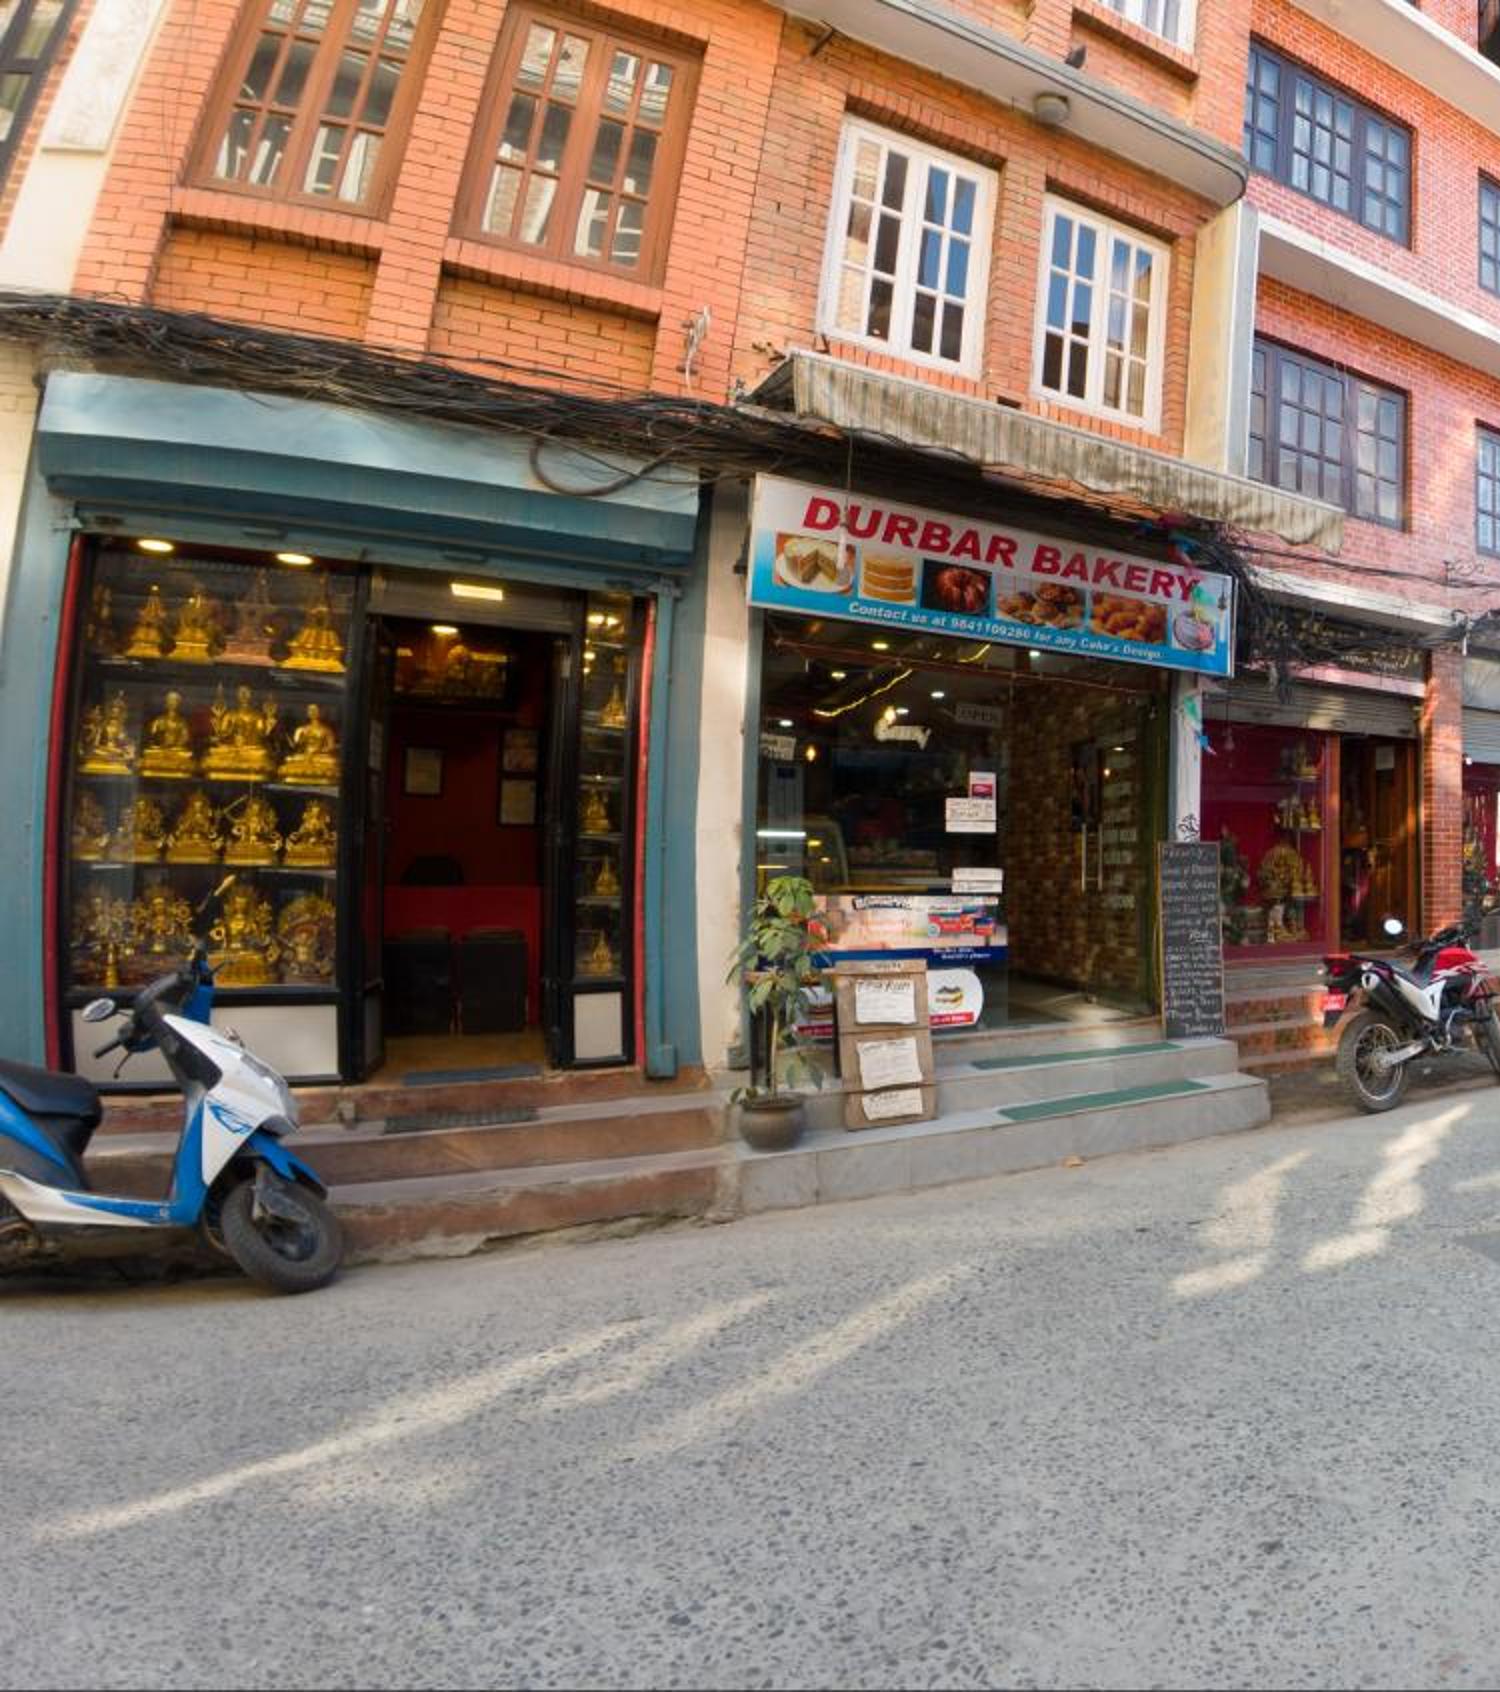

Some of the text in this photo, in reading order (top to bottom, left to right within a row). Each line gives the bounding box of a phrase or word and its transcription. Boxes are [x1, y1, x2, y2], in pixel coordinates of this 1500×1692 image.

[803, 496, 1203, 602] DURBAR BAKERY
[849, 601, 908, 620] Contact
[911, 613, 928, 623] us
[931, 615, 946, 626] at
